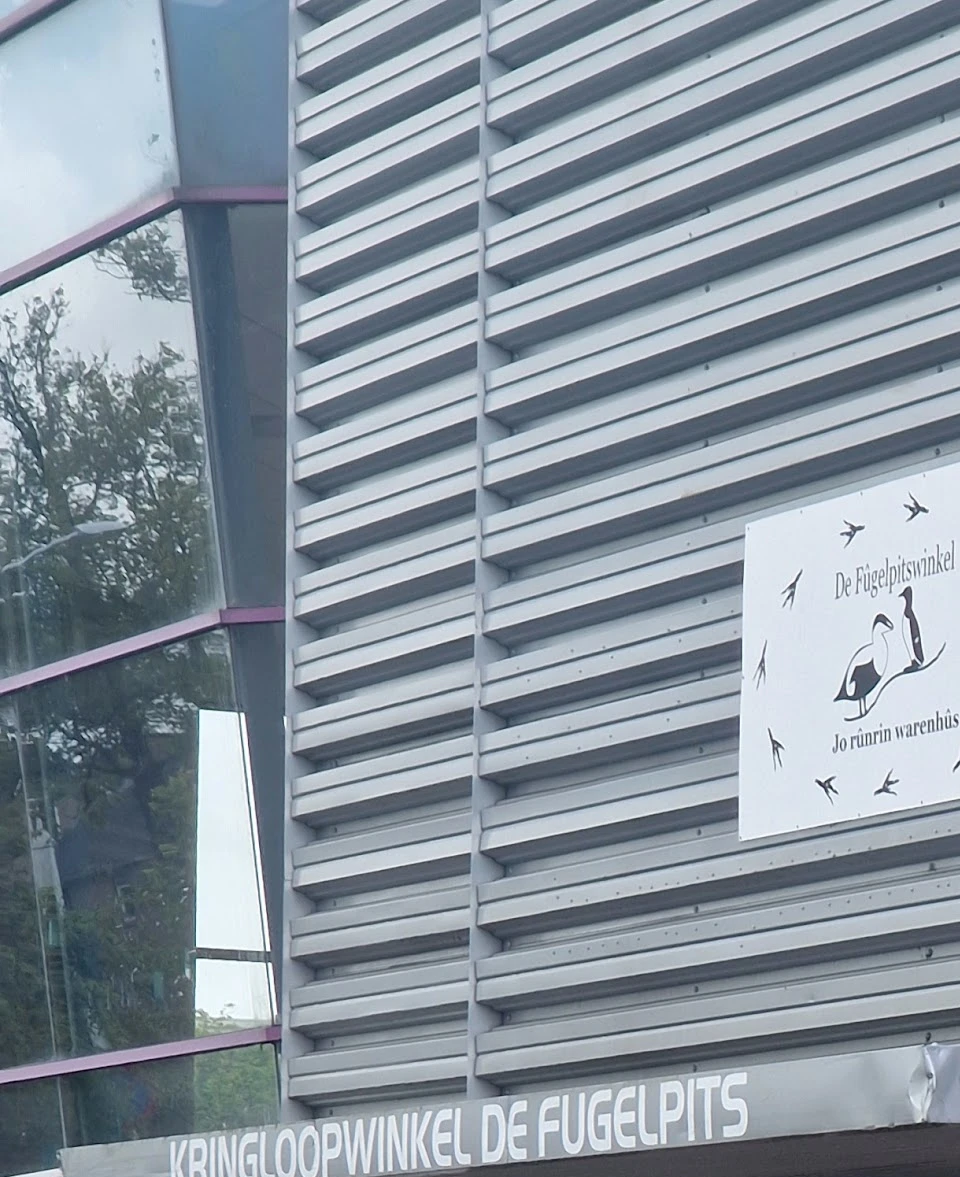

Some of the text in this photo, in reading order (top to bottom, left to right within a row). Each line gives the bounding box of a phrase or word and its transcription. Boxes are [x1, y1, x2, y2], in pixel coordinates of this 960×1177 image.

[835, 539, 955, 599] De Fûgelpitswinkel
[832, 734, 848, 754] Jo
[895, 707, 960, 740] warenhûs
[481, 1100, 527, 1163] DE
[537, 1071, 749, 1157] FUGELPITS
